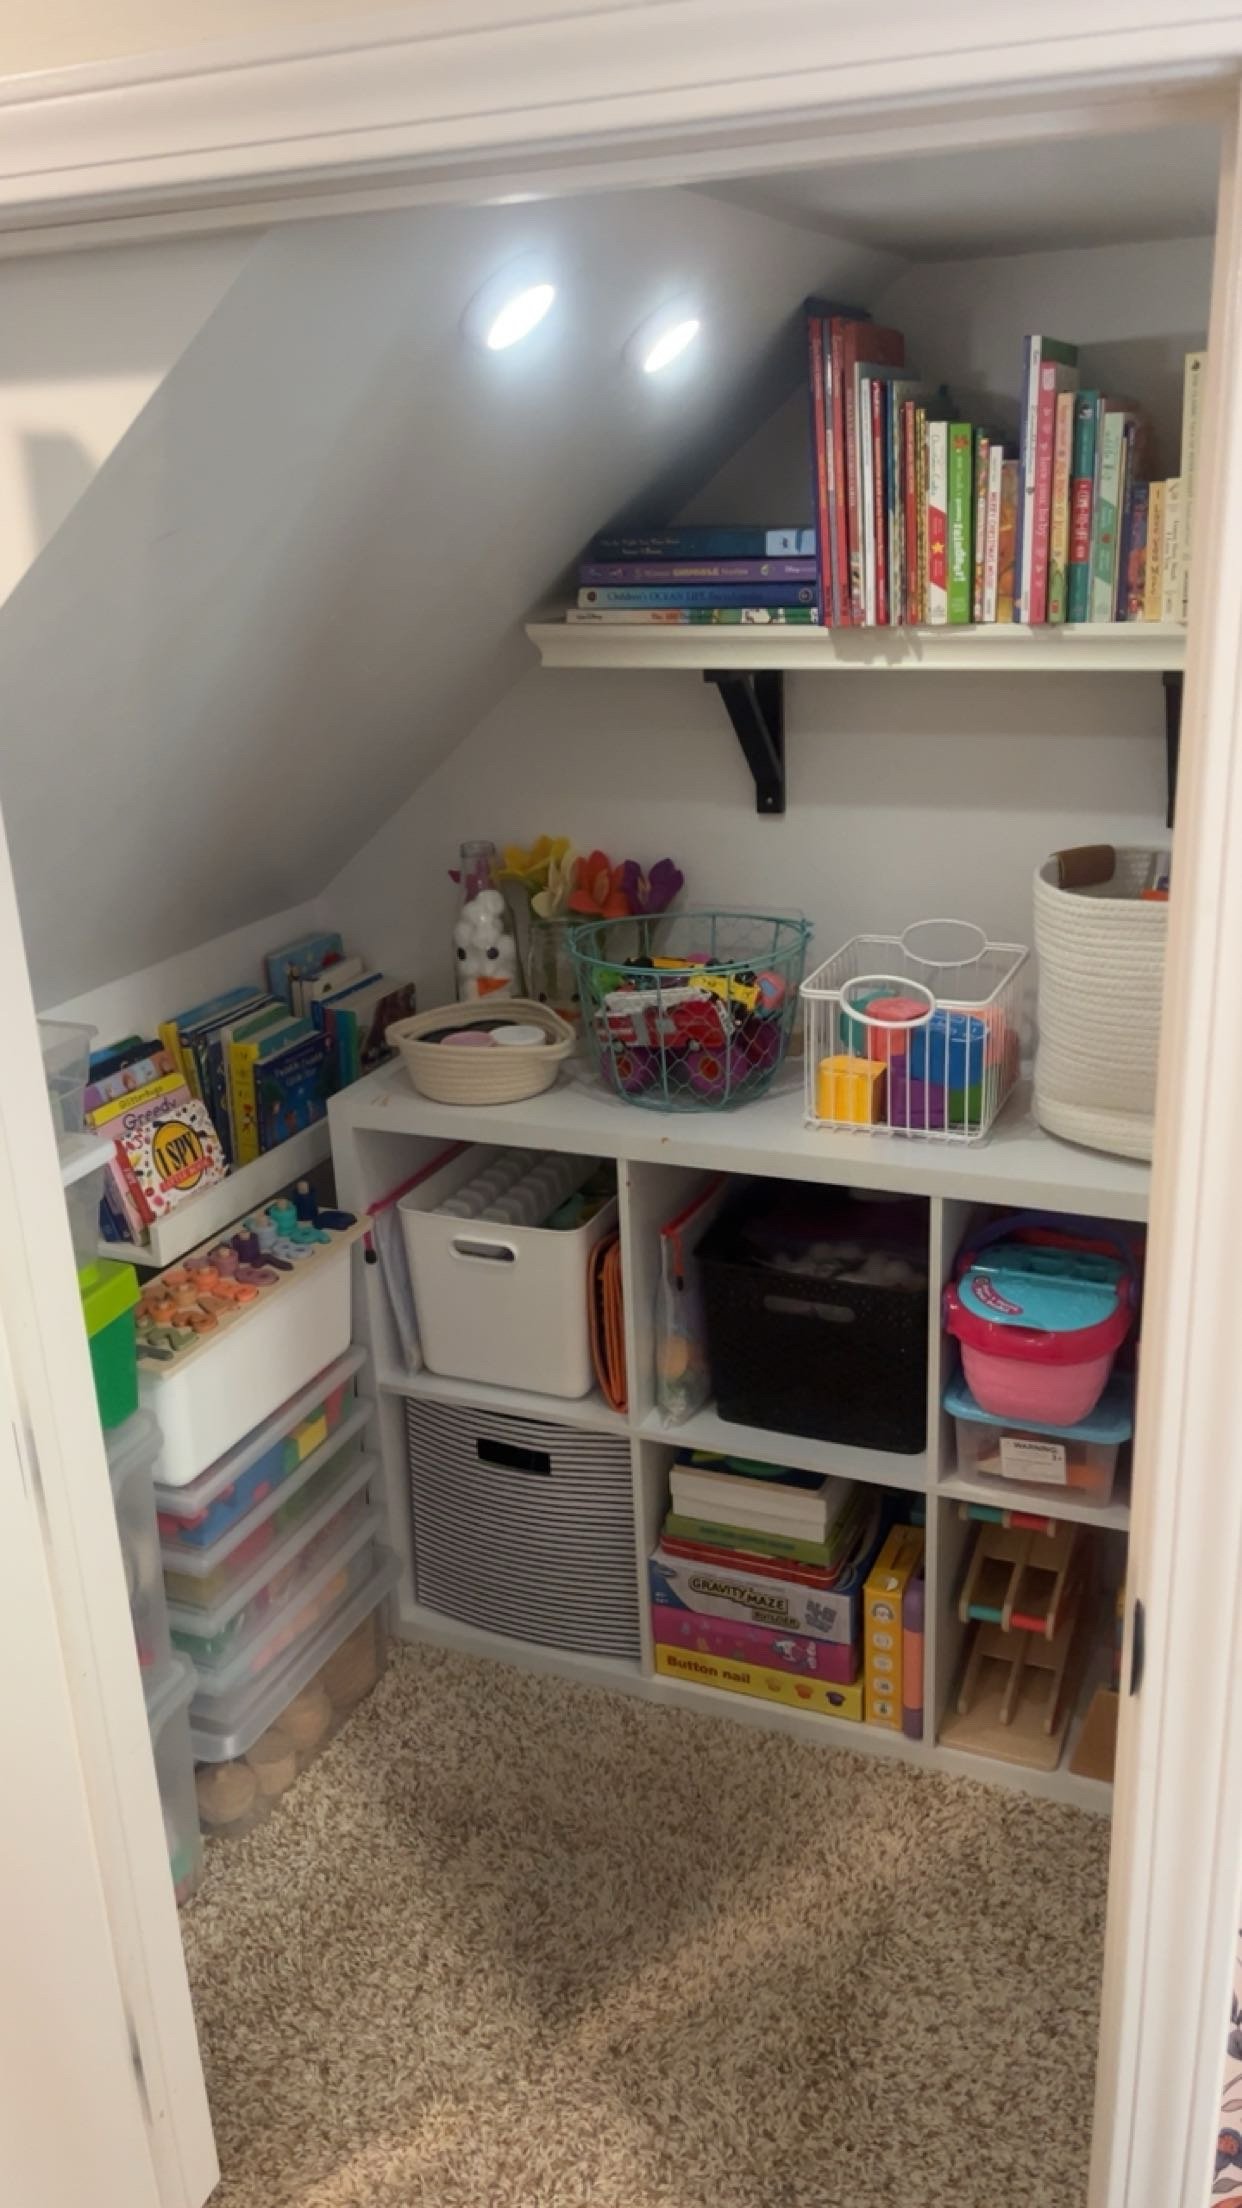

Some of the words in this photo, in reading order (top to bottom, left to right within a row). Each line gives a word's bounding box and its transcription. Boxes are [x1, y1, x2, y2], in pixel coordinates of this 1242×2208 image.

[156, 1147, 173, 1179] I
[164, 1130, 200, 1172] SPY
[691, 1577, 748, 1599] GRAVITY
[748, 1592, 785, 1611] MAZE
[666, 1655, 719, 1677] Button
[722, 1667, 751, 1684] nail
